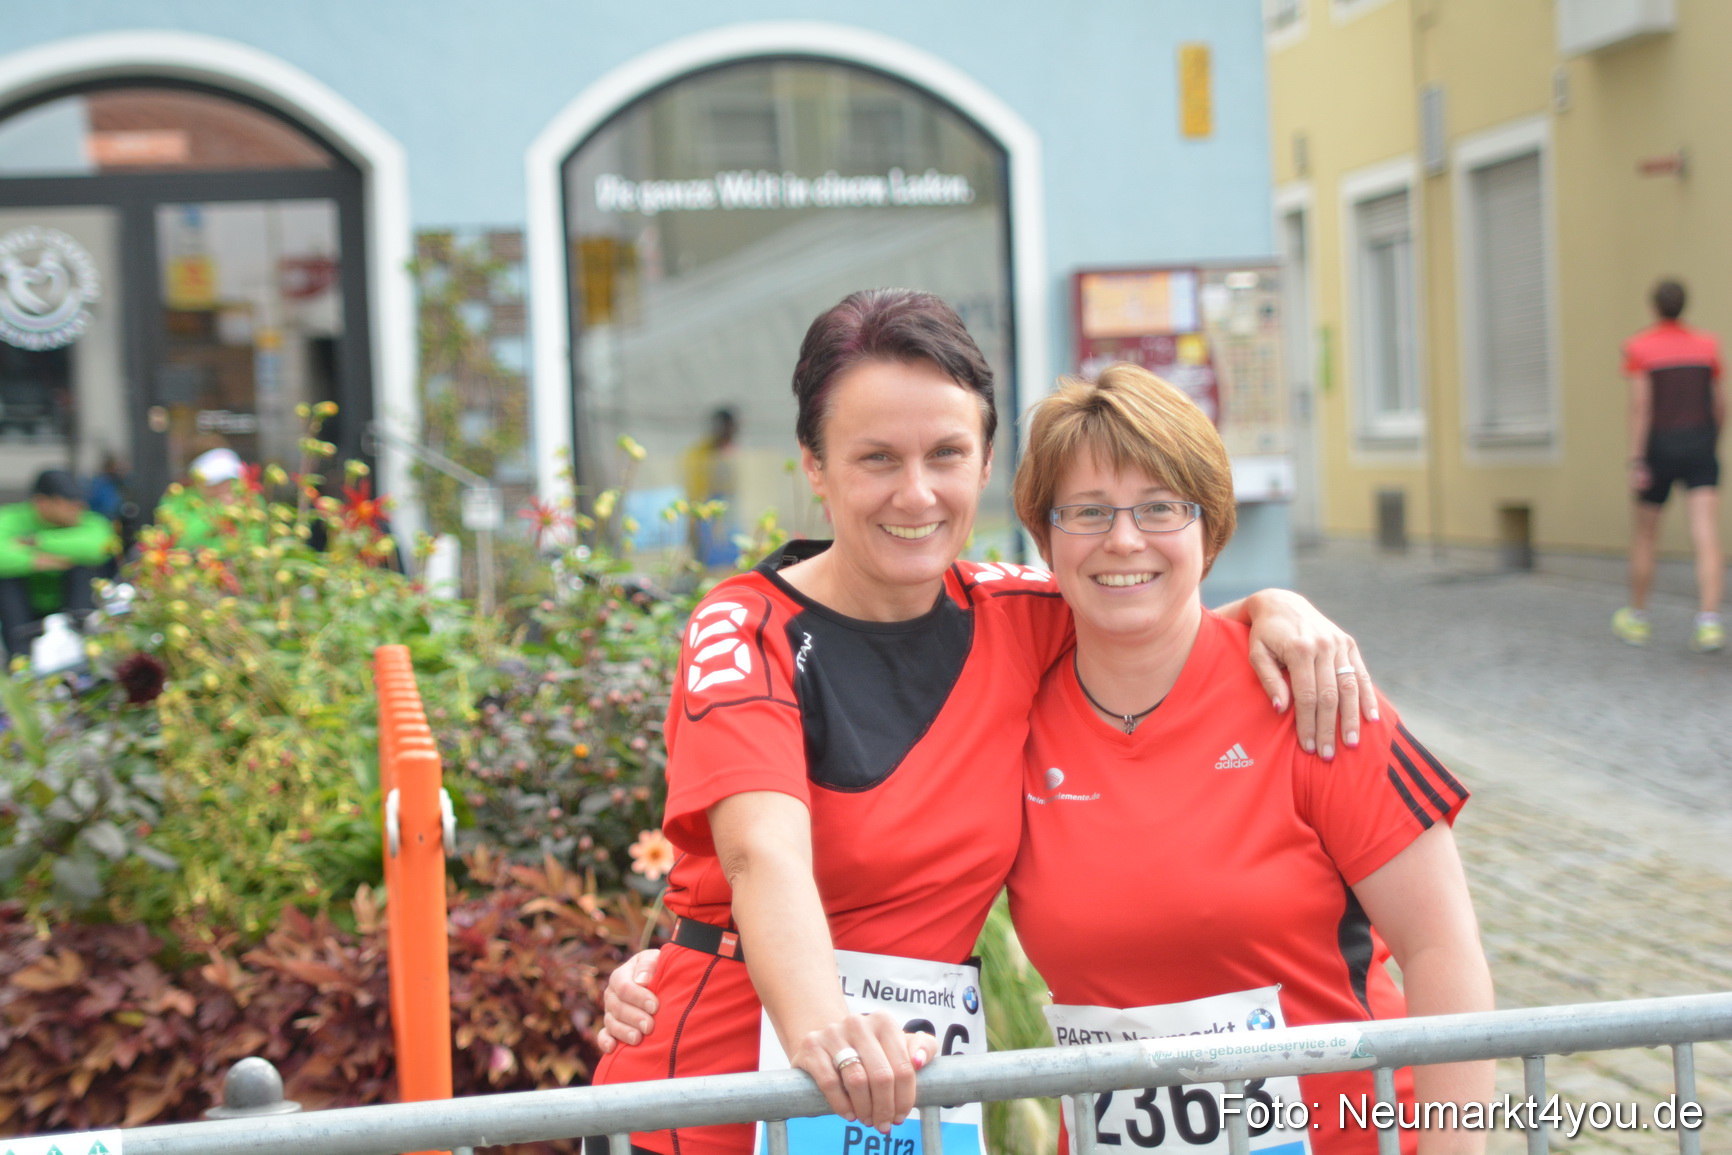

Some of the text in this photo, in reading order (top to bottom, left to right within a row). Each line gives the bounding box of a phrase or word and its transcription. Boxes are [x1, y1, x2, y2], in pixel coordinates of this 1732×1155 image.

[638, 179, 716, 214] ganze
[717, 170, 780, 209] Welt
[1214, 758, 1254, 769] adidas
[861, 978, 956, 1010] Neumarkt
[1149, 1036, 1347, 1061] ww.jura-gebaeudeservice.de
